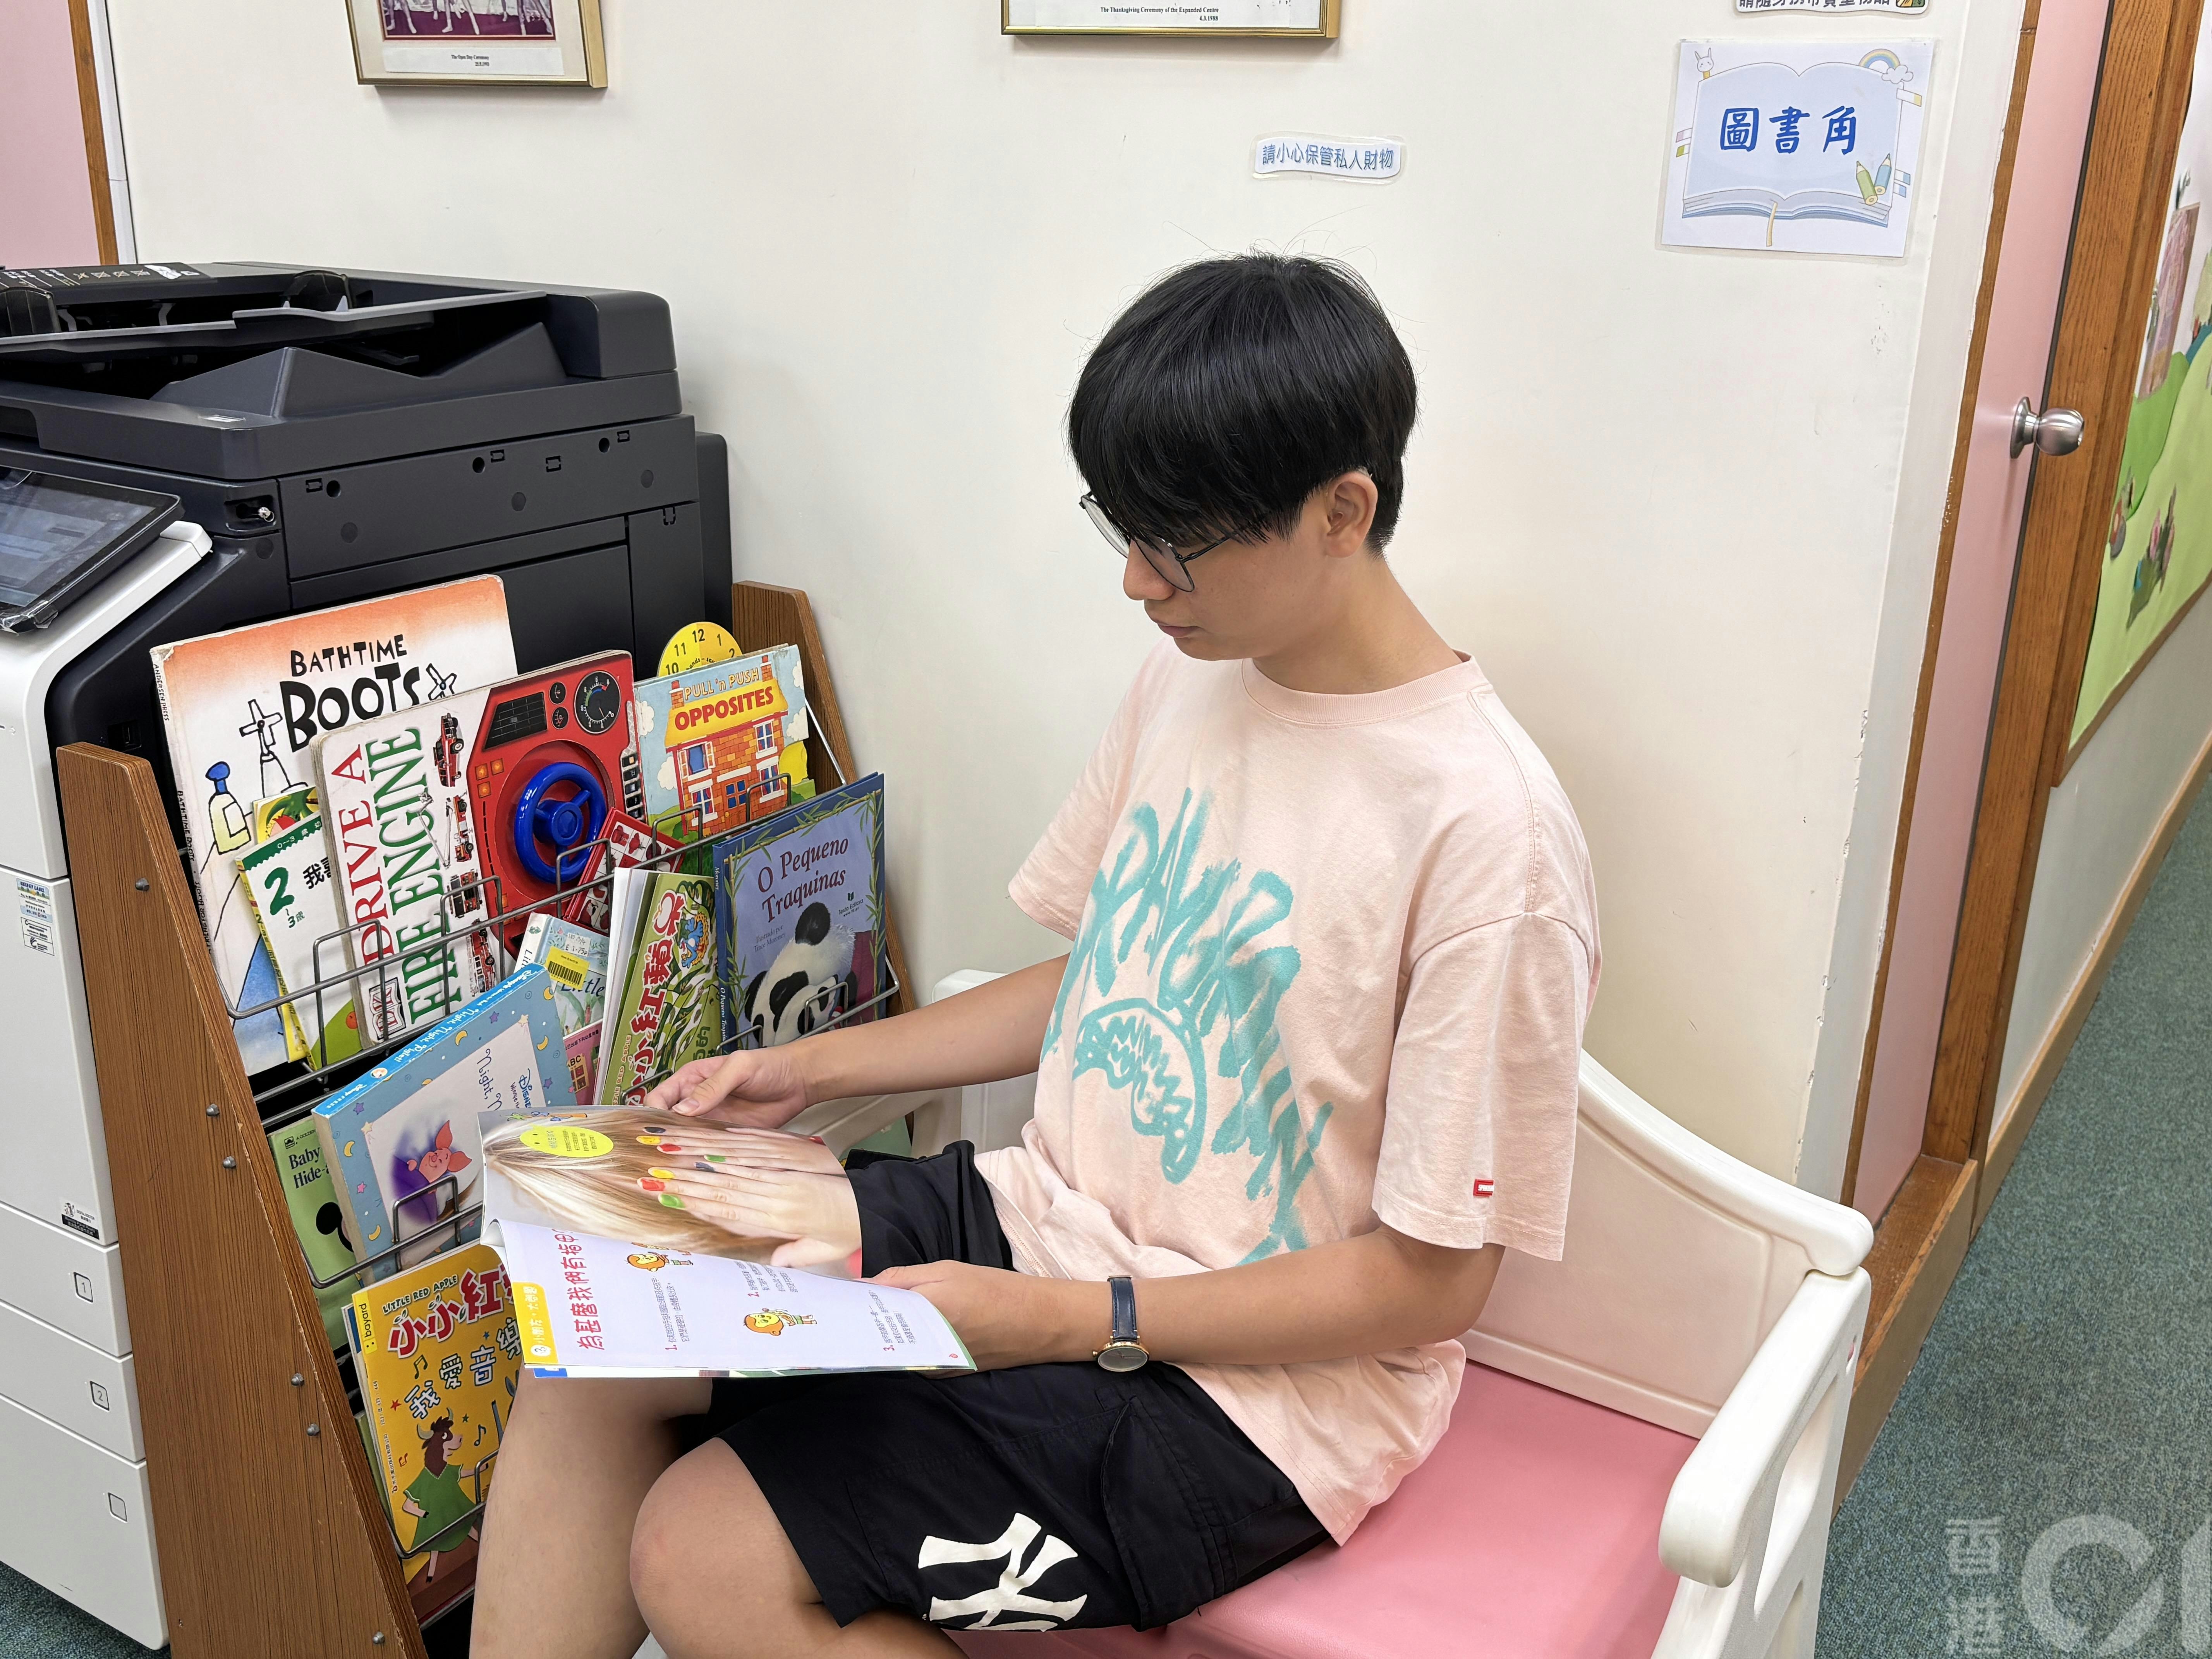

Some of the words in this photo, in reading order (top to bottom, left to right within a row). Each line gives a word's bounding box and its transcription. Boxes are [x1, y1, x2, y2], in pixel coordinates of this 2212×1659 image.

[1720, 105, 1858, 155] 圖書角
[1262, 142, 1394, 170] 請小心保管私人財物
[291, 634, 407, 677] BATHTIME
[674, 642, 687, 656] 11
[692, 629, 705, 643] 12
[717, 634, 721, 646] 1
[153, 663, 165, 701] ANDERSEN
[665, 662, 679, 675] 10
[684, 683, 715, 701] PULL
[728, 667, 759, 688] PUSH
[279, 662, 421, 753] BOOTS
[675, 686, 774, 731] OPPOSITES
[331, 744, 365, 784] A
[177, 790, 190, 835] BATHTIME
[364, 728, 444, 916] ENGINE
[339, 800, 395, 967] DRIVE
[757, 866, 774, 894] O
[780, 837, 849, 881] Pequeno
[762, 867, 847, 924] Traquinas
[396, 913, 462, 1024] FIRE
[477, 1048, 494, 1100] Night,
[519, 1068, 533, 1109] DISNE
[289, 1146, 321, 1170] Baby
[81, 1281, 86, 1294] 1
[382, 1294, 411, 1316] LITTLE
[413, 1286, 430, 1302] RED
[433, 1274, 458, 1293] APPLE
[358, 1302, 373, 1338] bayard
[97, 1391, 103, 1401] 2
